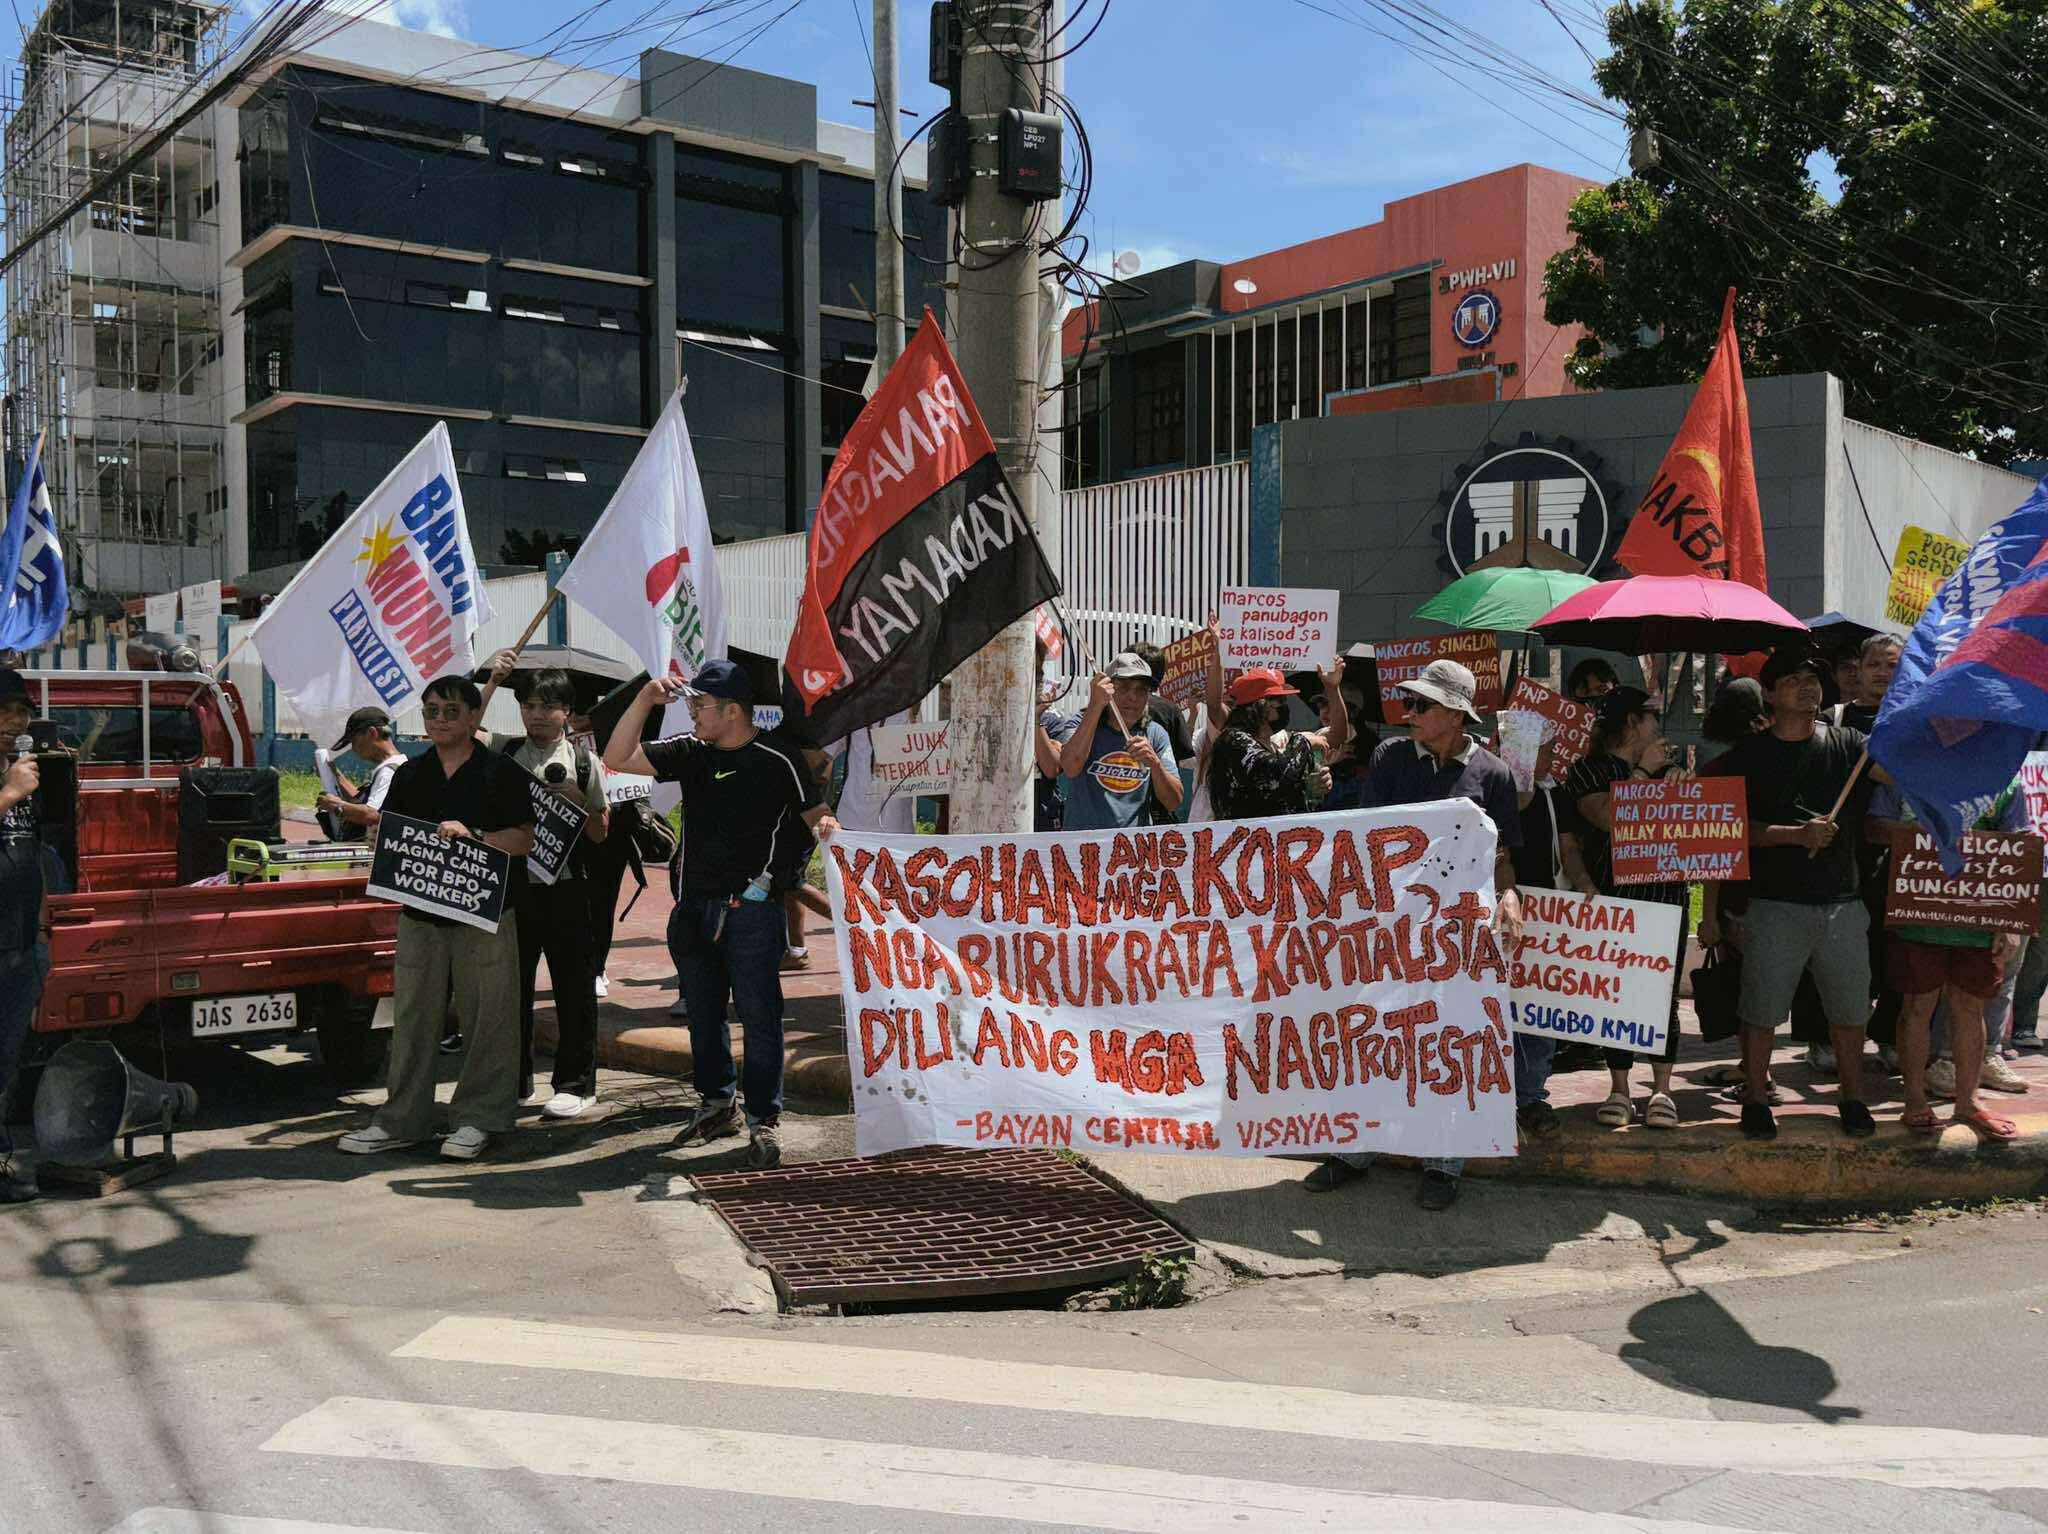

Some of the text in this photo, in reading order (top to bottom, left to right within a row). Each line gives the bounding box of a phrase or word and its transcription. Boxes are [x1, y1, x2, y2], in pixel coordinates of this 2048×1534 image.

[1906, 550, 1955, 577] serb
[365, 543, 455, 681] MUNA
[1242, 609, 1328, 627] panubagon
[1885, 597, 1921, 626] BAYA
[1220, 627, 1321, 641] sa kalisod sa
[1228, 643, 1310, 658] katawhan!
[1239, 660, 1298, 671] KMP CEBU
[1515, 681, 1549, 704] PNP
[1557, 698, 1577, 719] TO
[901, 730, 949, 754] JUNK
[878, 760, 931, 782] TERROR
[529, 781, 580, 829] INALIZE
[616, 783, 651, 801] CEBU
[1613, 783, 1703, 801] MARCOS UG
[1615, 804, 1640, 822] MGA
[401, 825, 489, 865] PASS THE
[1613, 822, 1744, 842] WALAY KALAINAN
[383, 838, 446, 865] MAGNA
[449, 856, 500, 885] CARTA
[1612, 843, 1679, 860] PAREHONG
[1656, 850, 1743, 871] KAWATAN!
[400, 858, 480, 892] FOR BPO
[830, 825, 1430, 929] KASOHAN ANG MGA KORAP
[1683, 867, 1733, 881] KADAMAY
[393, 871, 491, 913] WORKERS
[1895, 878, 2040, 903] BUNGKAGON!
[1521, 894, 1636, 934] RUKRATA
[849, 891, 1507, 1007] NGA BURUKRATA KAPITALISTA
[1512, 931, 1675, 973] pitalismo
[1509, 962, 1622, 1003] BAGSAK!
[196, 1000, 294, 1028] JAS 2636
[1522, 1002, 1595, 1035] SUGBO
[859, 1001, 954, 1078] DILI
[973, 1006, 1079, 1077] ANG
[1088, 1029, 1205, 1096] MGA
[1085, 1116, 1222, 1151] CENTRAL
